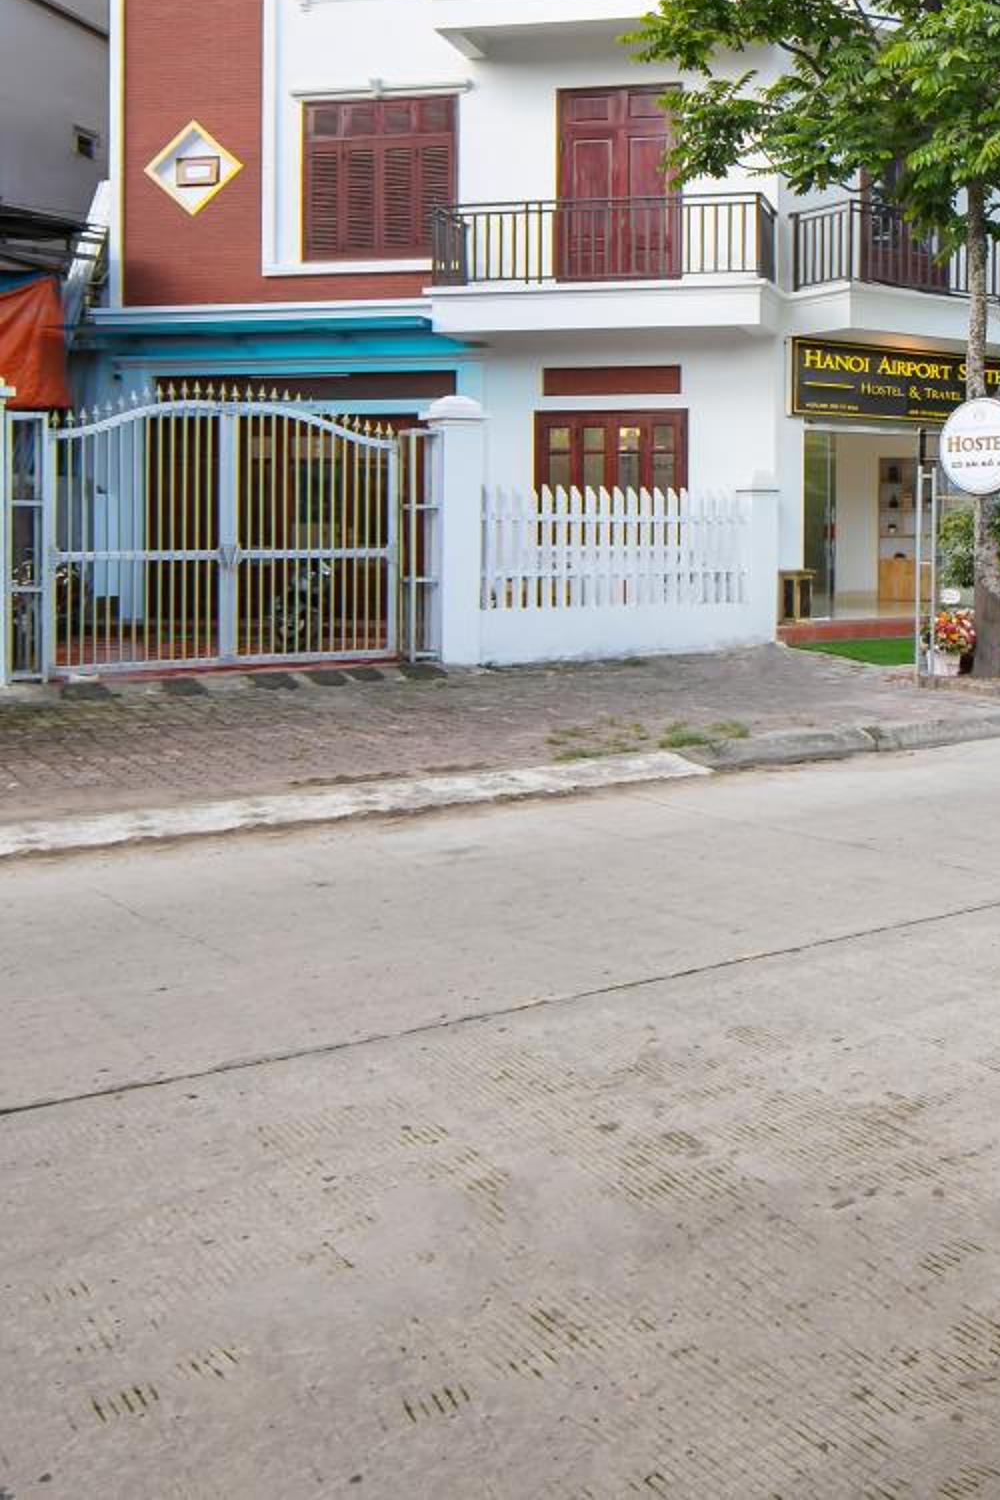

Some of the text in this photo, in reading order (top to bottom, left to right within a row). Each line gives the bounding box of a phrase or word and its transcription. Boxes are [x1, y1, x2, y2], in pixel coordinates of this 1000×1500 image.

[804, 349, 870, 373] HANOI
[877, 355, 952, 381] AIRPORT
[861, 380, 905, 397] HOSTEL
[908, 384, 922, 401] &
